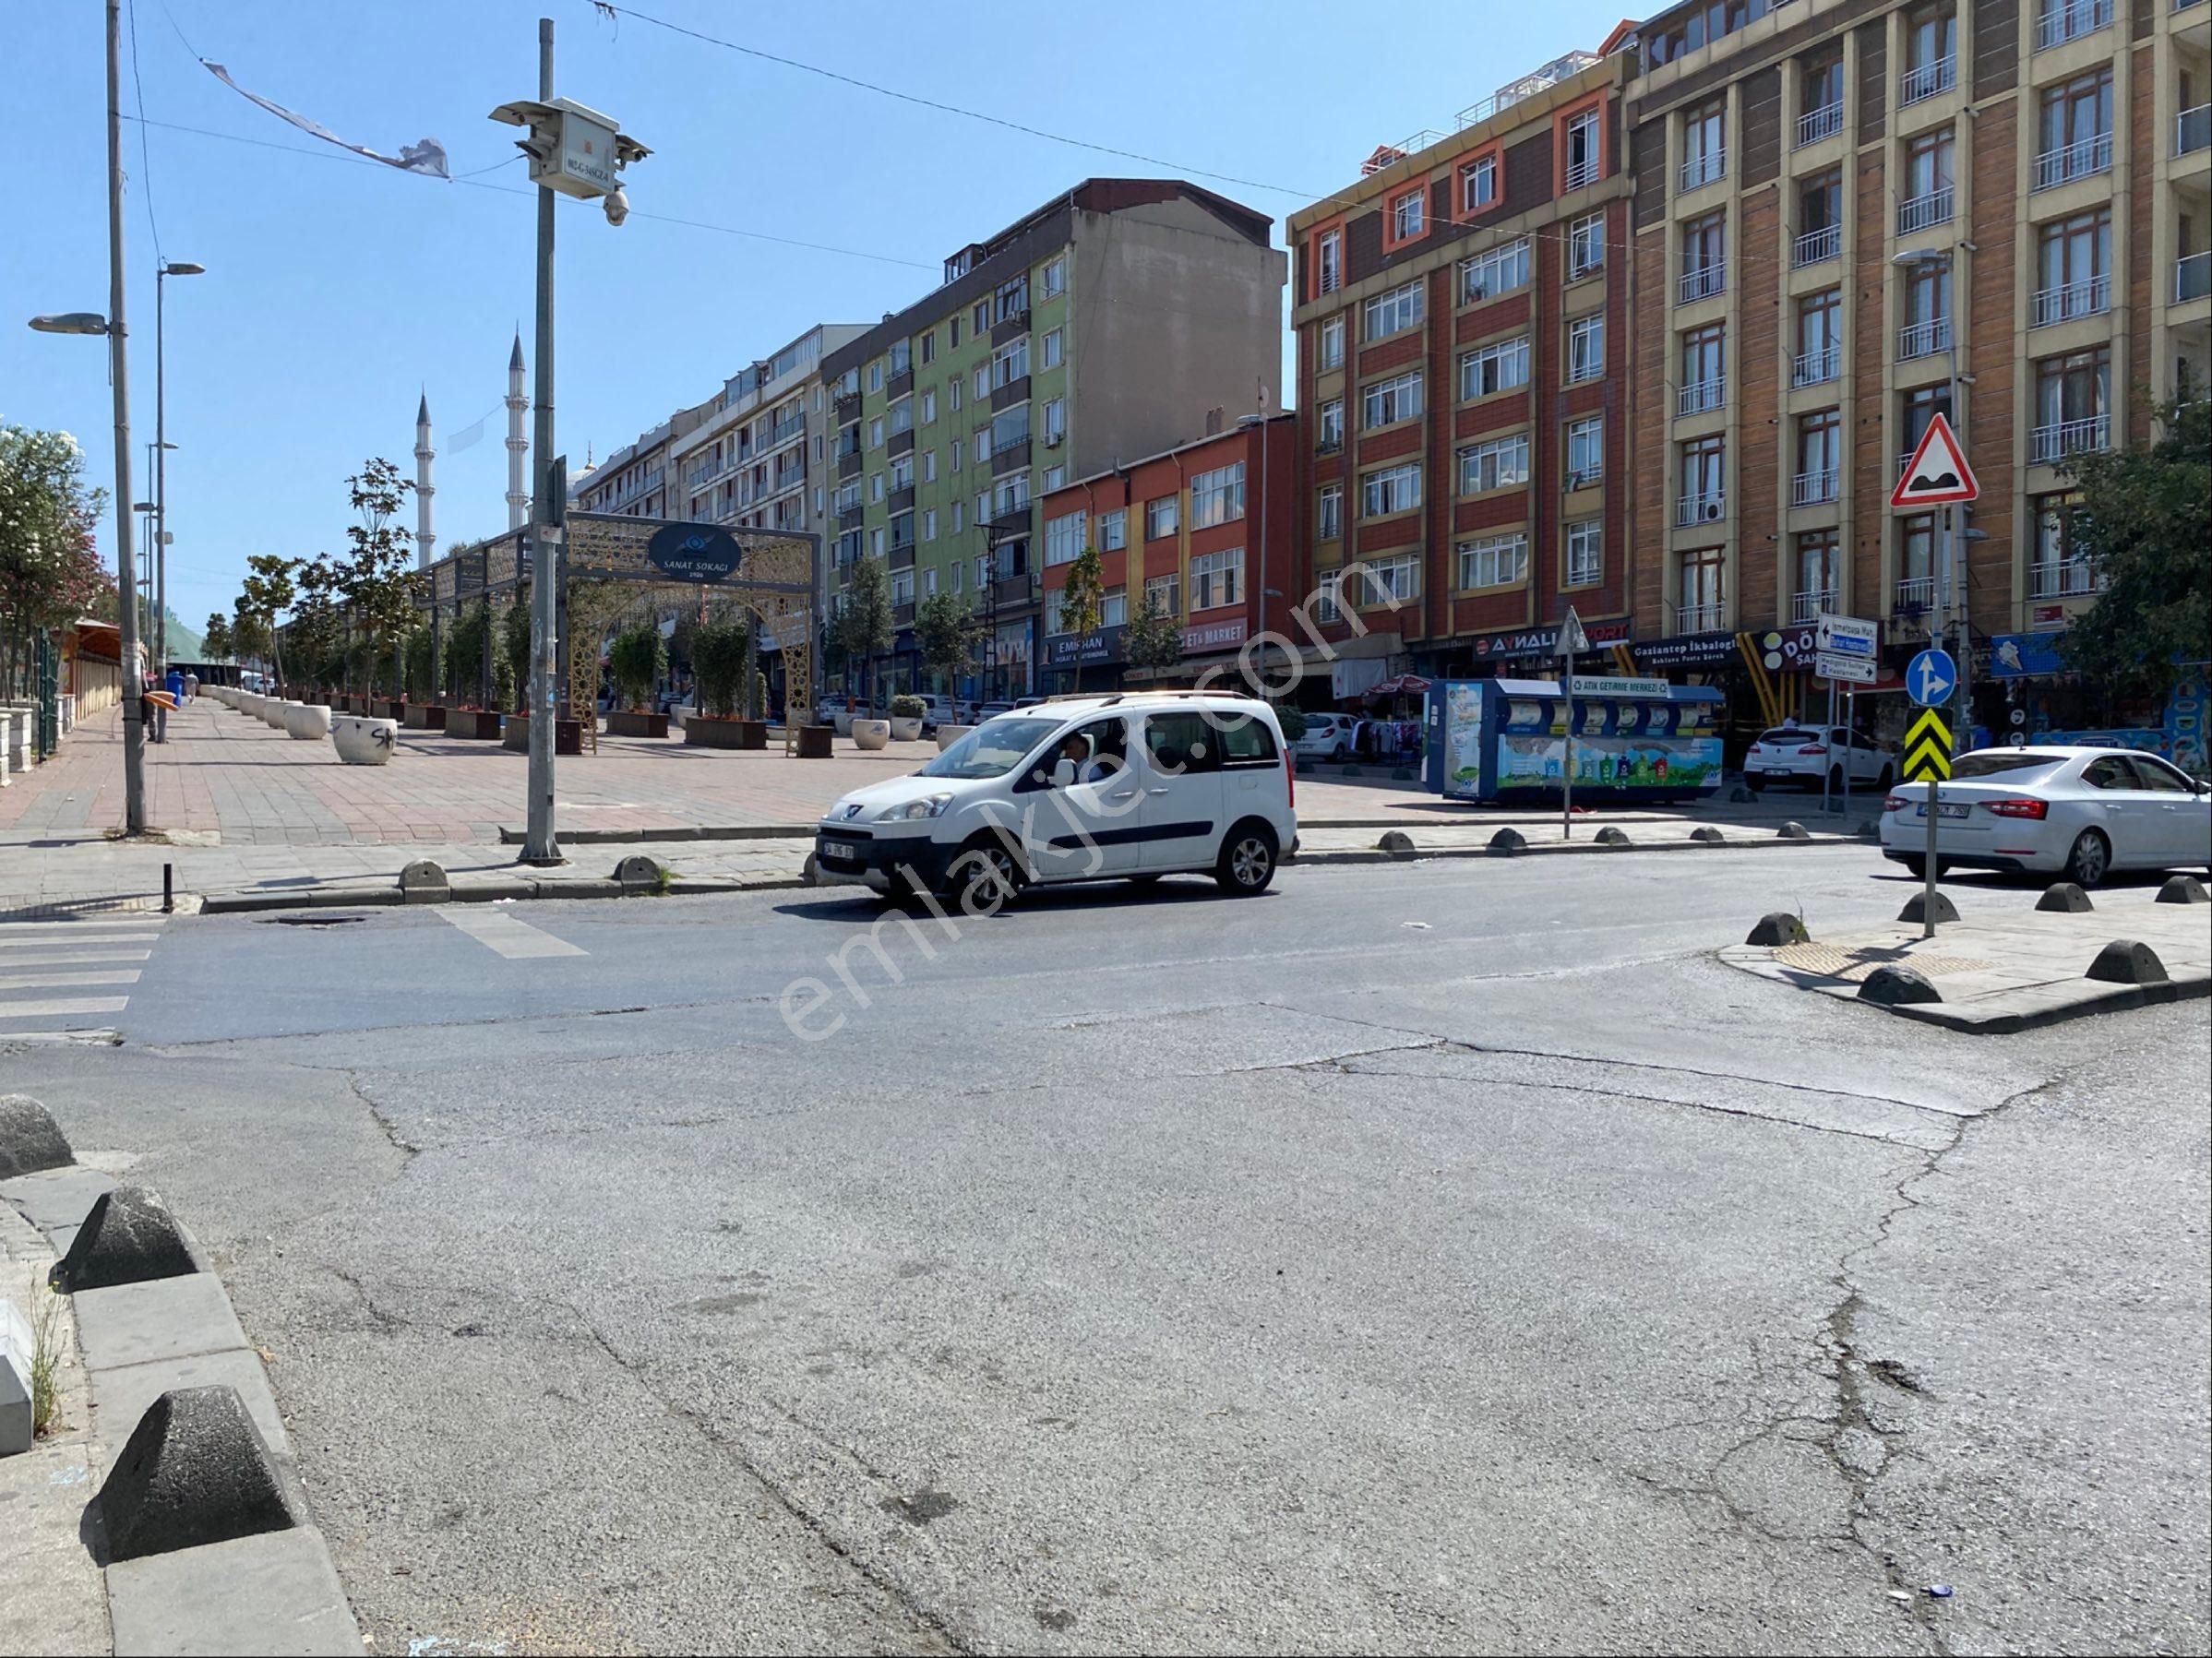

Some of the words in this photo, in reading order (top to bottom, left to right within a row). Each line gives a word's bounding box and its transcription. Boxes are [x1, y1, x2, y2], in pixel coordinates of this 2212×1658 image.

[664, 560, 693, 570] SANAT
[1205, 626, 1242, 645] MARKET
[1634, 645, 1687, 657] Gaziantep
[1583, 681, 1598, 690] ATIK
